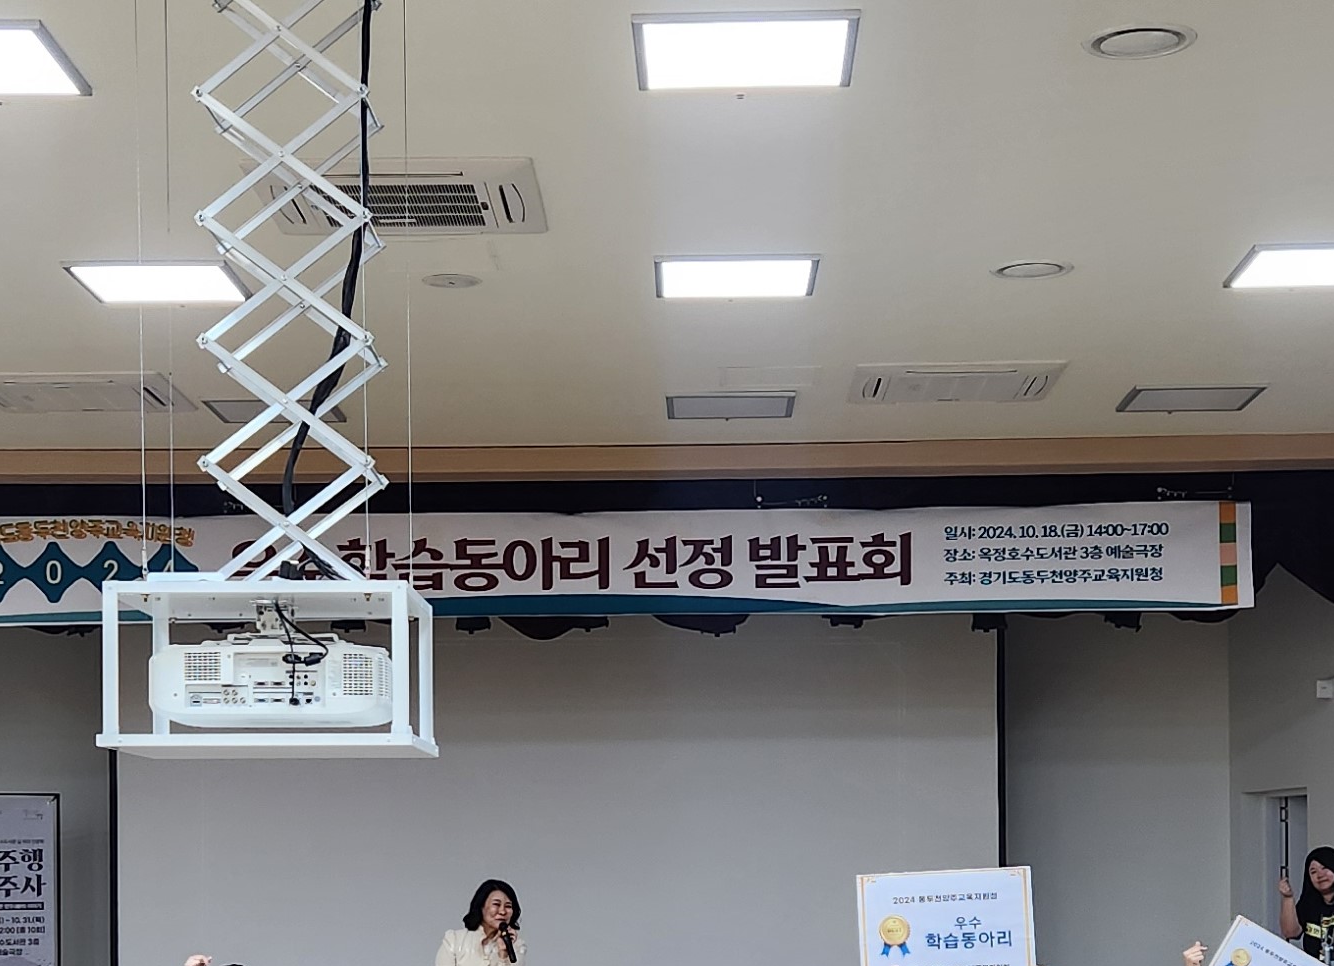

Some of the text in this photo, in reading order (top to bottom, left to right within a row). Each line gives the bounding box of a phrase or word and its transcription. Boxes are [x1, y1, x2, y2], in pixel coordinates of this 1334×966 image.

[944, 526, 976, 540] 일시:
[1087, 522, 1169, 537] 14:00~17:00
[623, 535, 734, 589] 선정
[748, 532, 913, 588] 발표회
[944, 543, 1163, 562] 장소: 옥정호수도서관 3층 예술극장
[944, 567, 1164, 585] 주최: 경기도동두천양주교육지원청
[893, 896, 915, 904] 2024
[954, 916, 981, 929] 우수
[925, 930, 1012, 949] 학습동아리
